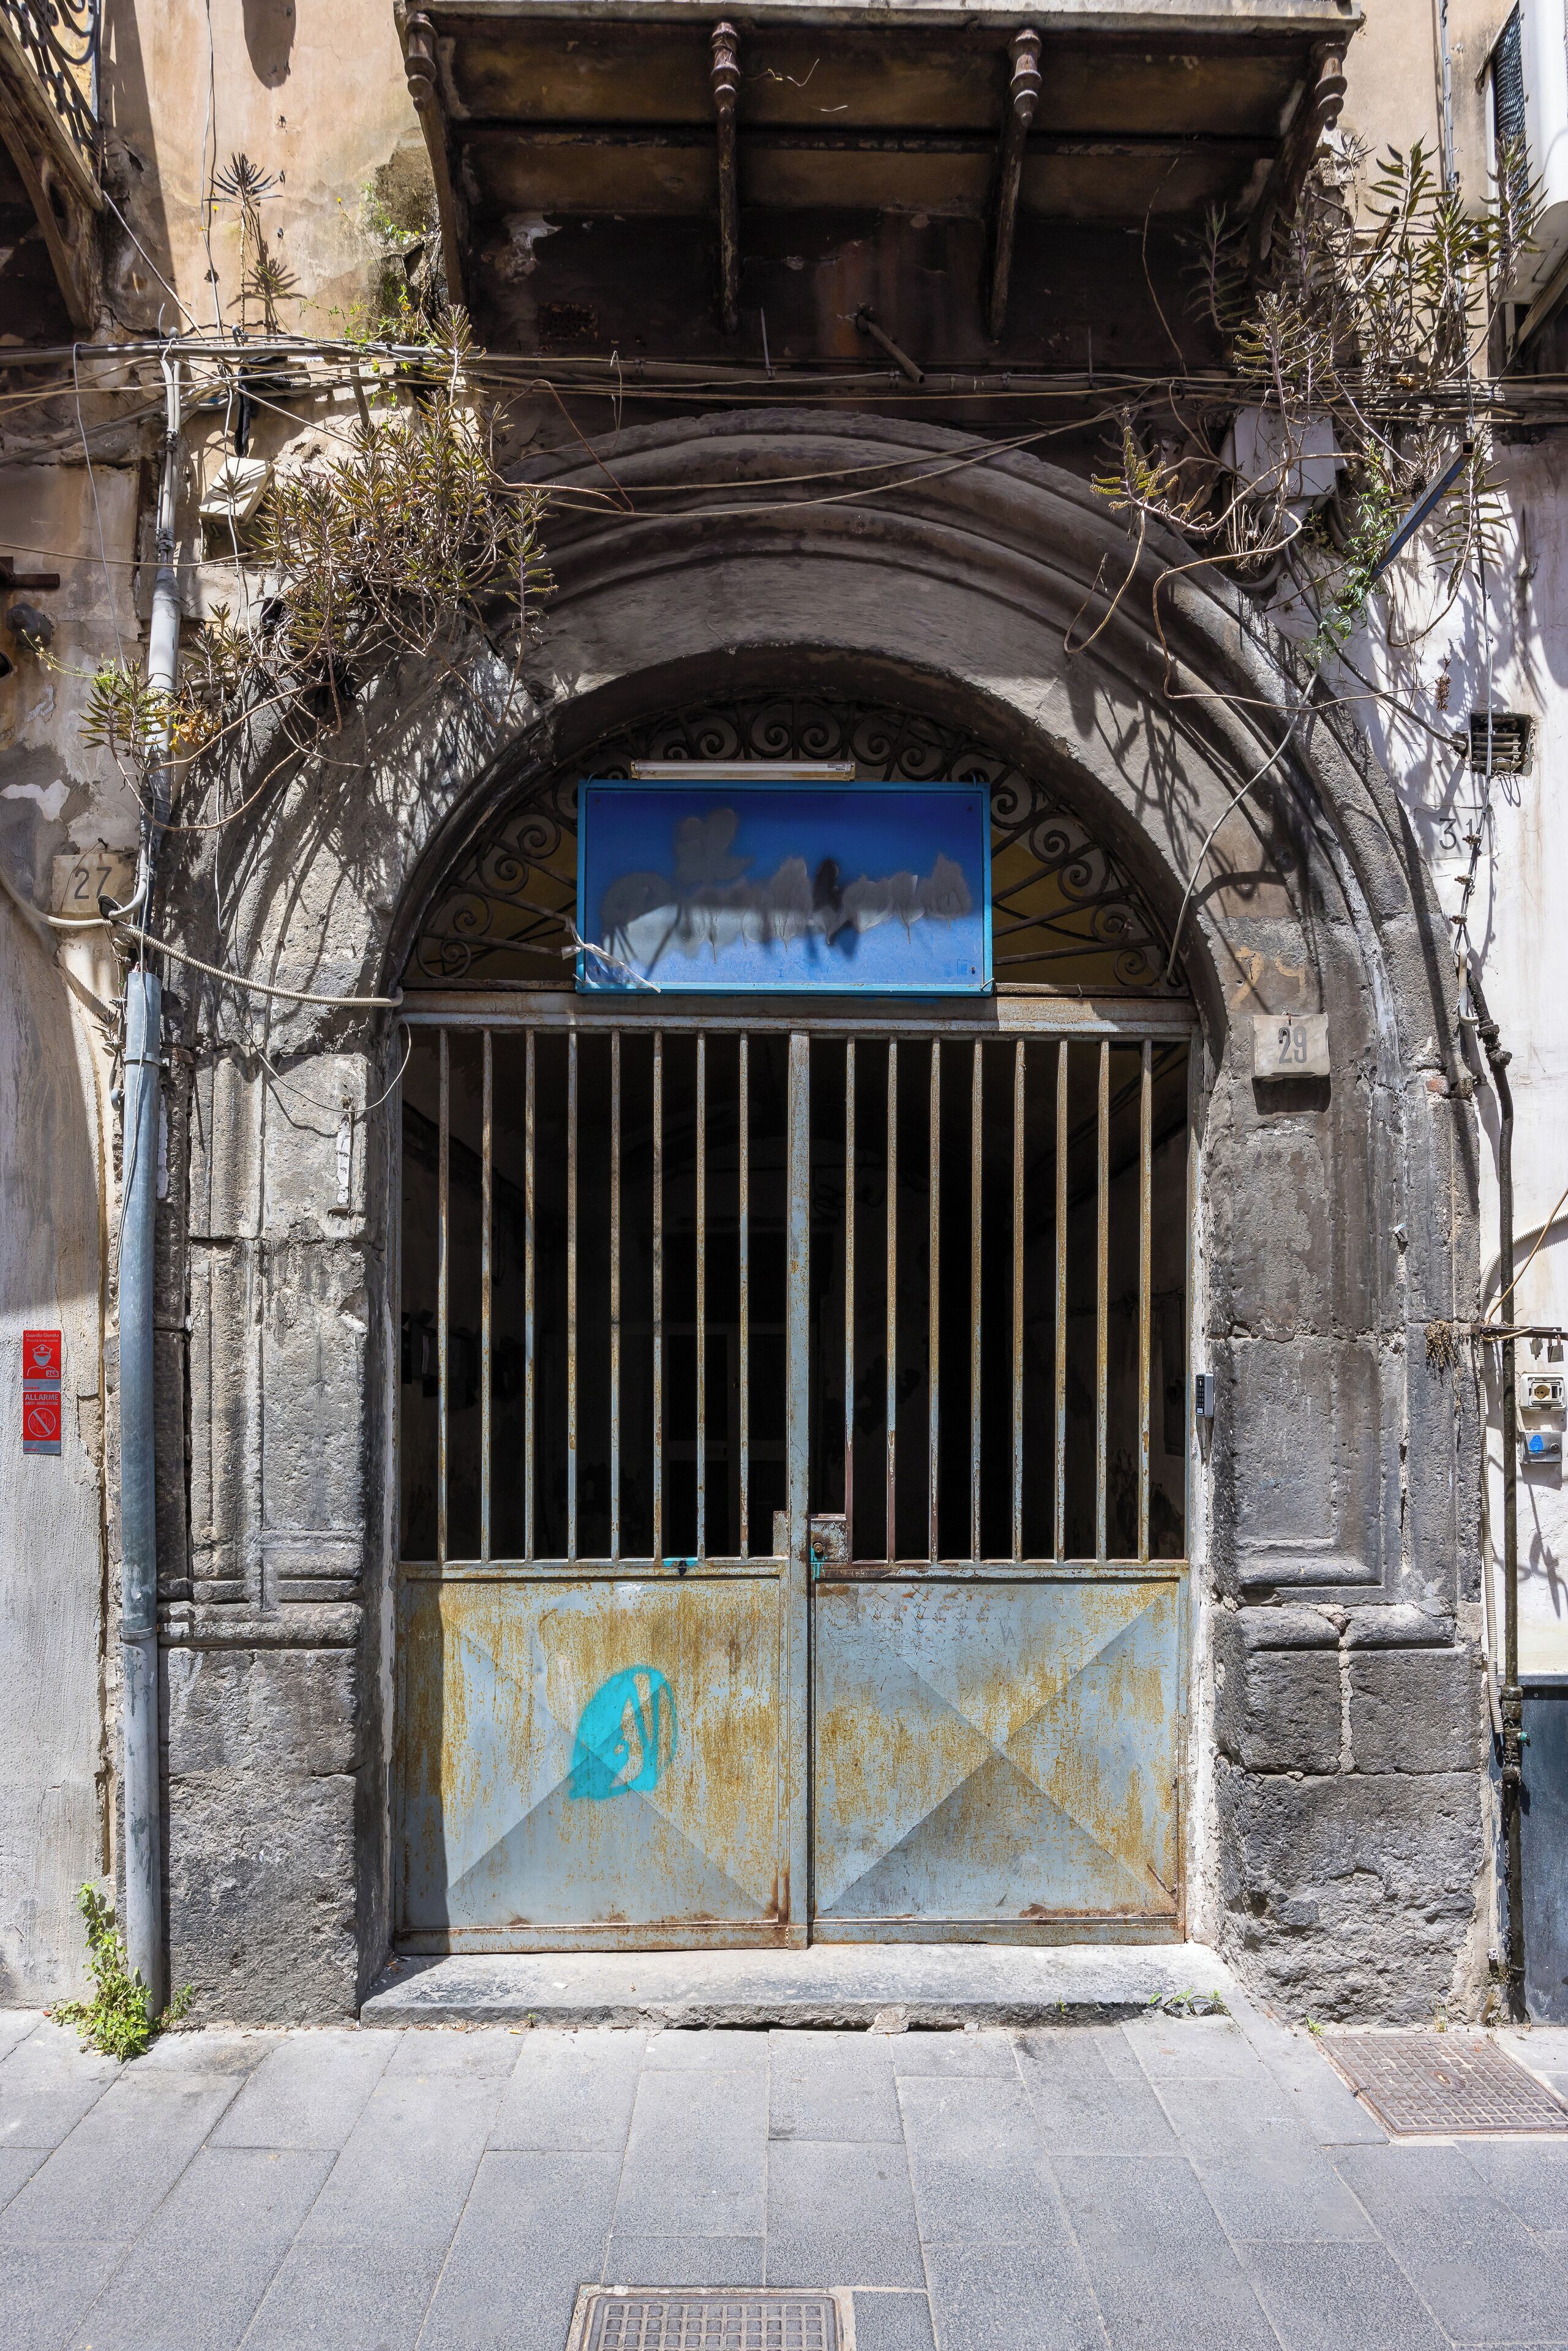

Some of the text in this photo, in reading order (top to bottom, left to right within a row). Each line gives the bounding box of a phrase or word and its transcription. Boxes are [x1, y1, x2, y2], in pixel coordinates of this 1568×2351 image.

[1439, 818, 1472, 850] 31
[74, 867, 112, 899] 27
[1278, 1026, 1307, 1063] 29
